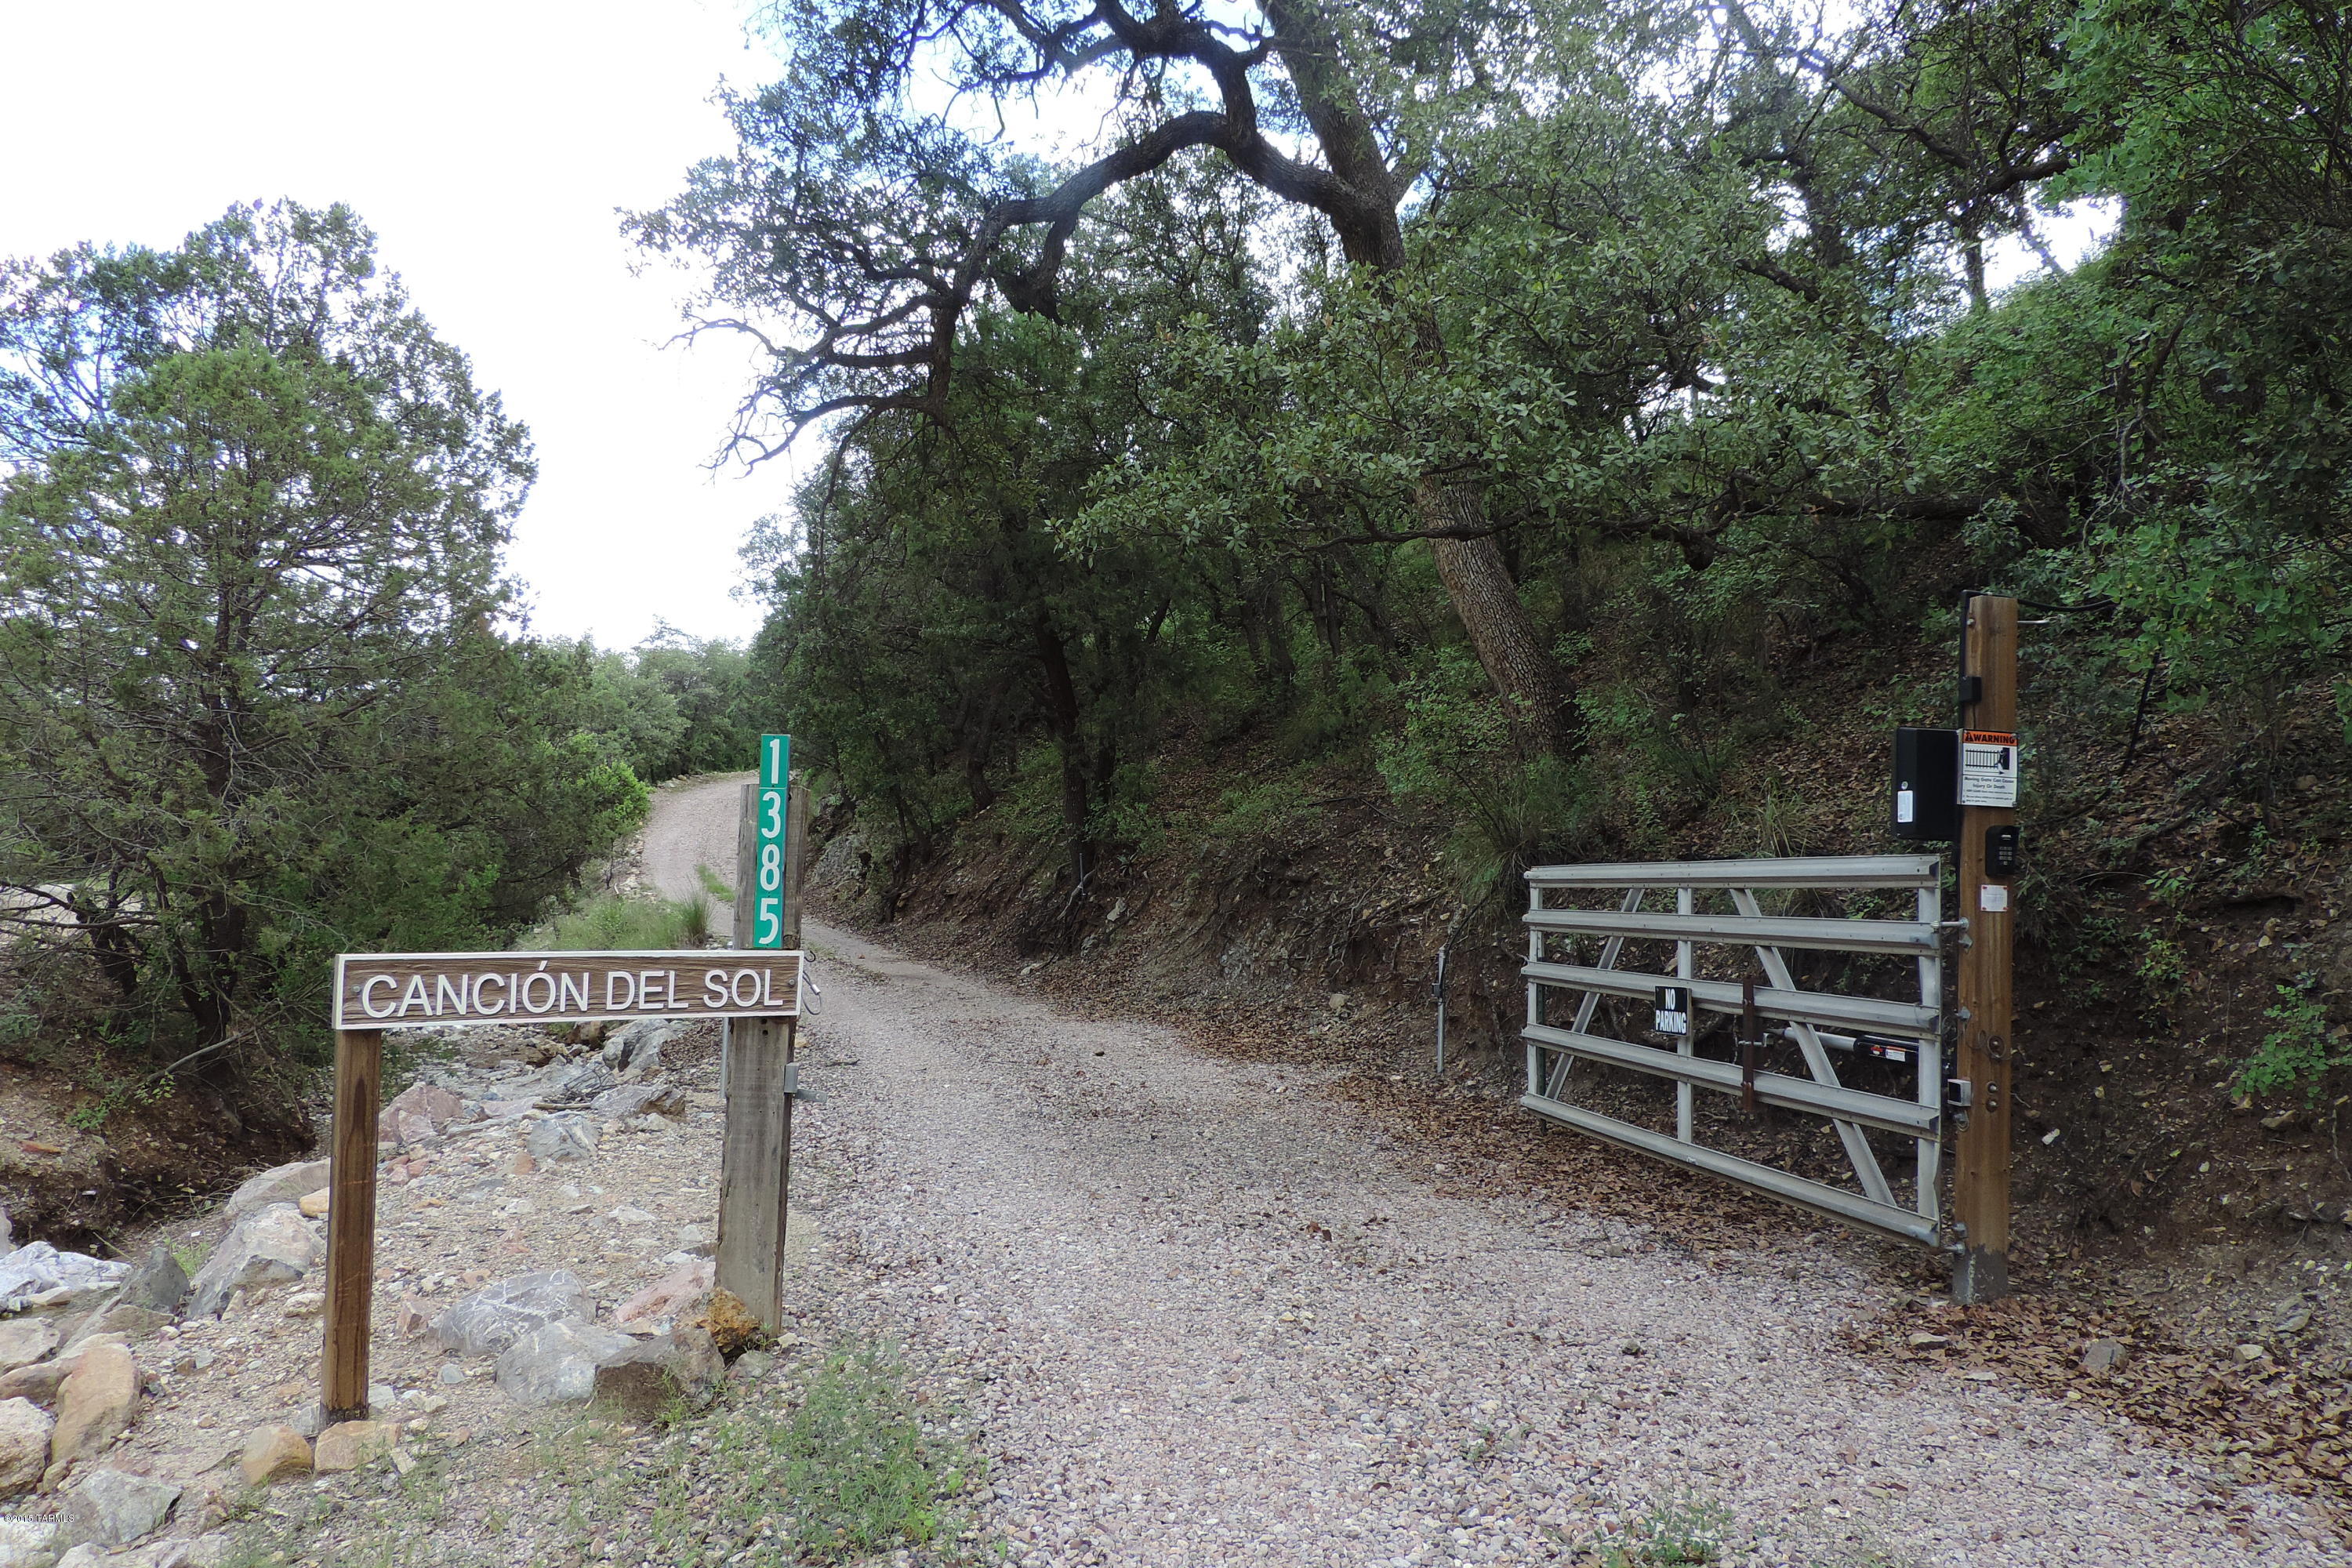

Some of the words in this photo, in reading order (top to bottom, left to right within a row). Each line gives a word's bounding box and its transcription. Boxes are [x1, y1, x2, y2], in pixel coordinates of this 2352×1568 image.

[1973, 734, 2015, 744] WARNING
[758, 739, 781, 944] 1385
[361, 960, 590, 1018] CANCIÓN
[606, 970, 689, 1011] DEL
[702, 968, 784, 1009] SOL
[1665, 989, 1676, 1010] NO
[1656, 1010, 1686, 1033] PARKING
